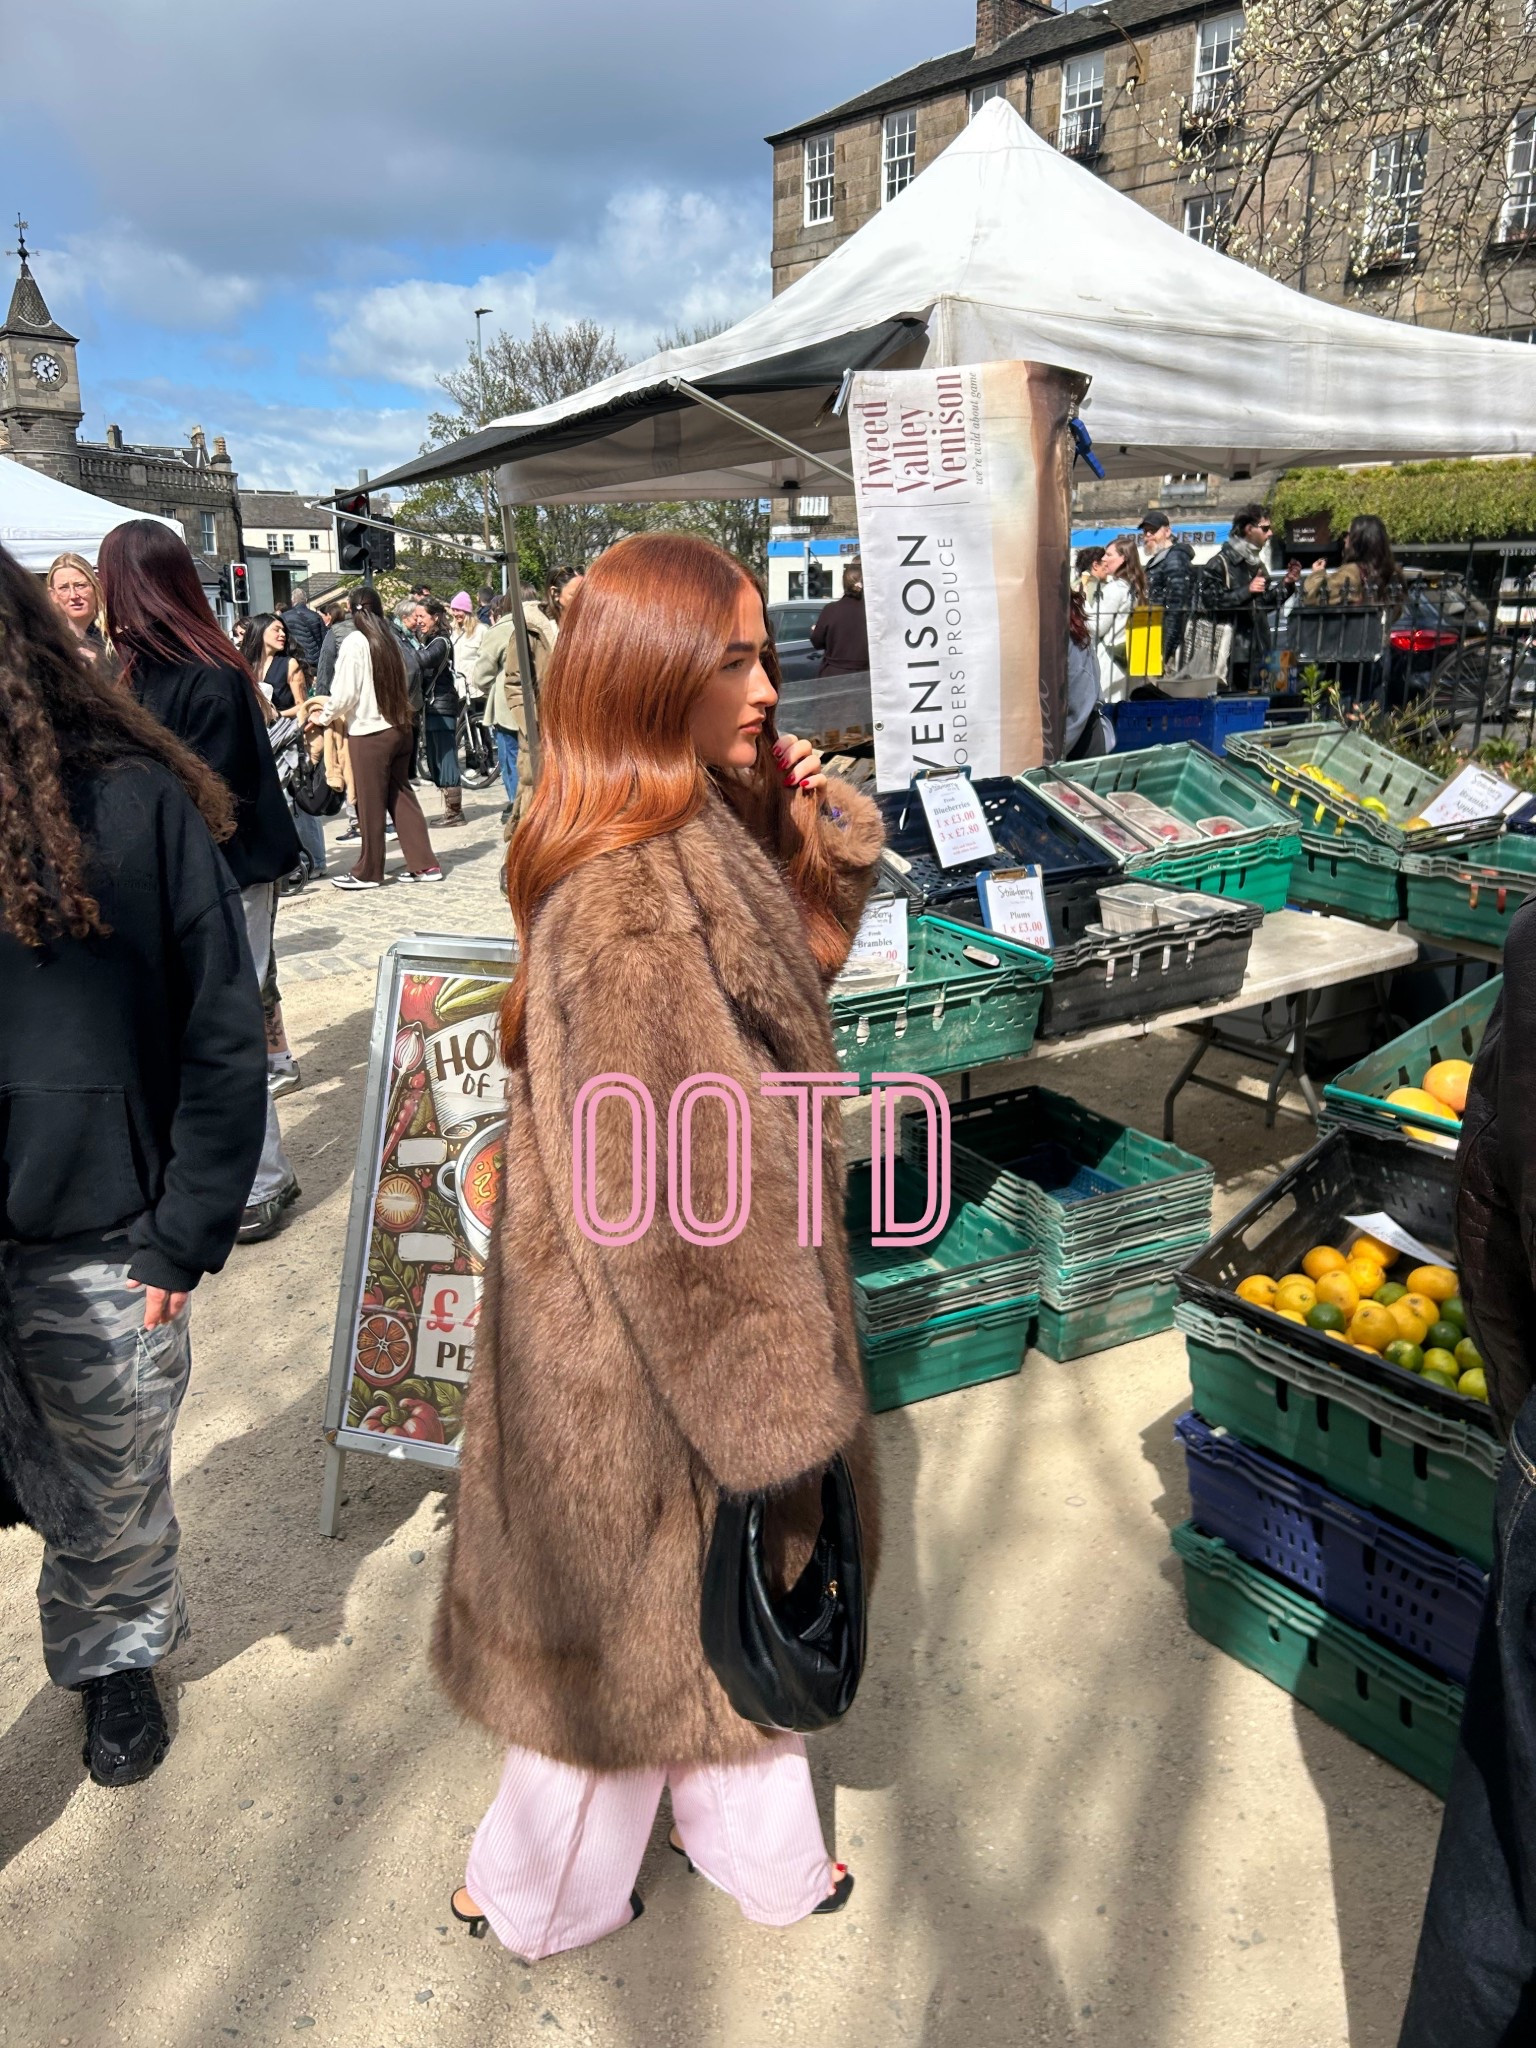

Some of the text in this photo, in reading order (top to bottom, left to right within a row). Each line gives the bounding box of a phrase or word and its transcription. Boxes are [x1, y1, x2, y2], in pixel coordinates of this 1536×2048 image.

[932, 373, 968, 493] Venison
[969, 372, 984, 485] we're wild about game
[853, 400, 894, 495] Tweed
[893, 404, 934, 494] Valley
[937, 538, 962, 655] PRODUCE
[933, 801, 971, 815] Blueberries
[936, 811, 976, 828] 1 x £3.00
[940, 824, 979, 842] 3 x £7.80
[1010, 911, 1031, 919] Plums
[1003, 924, 1007, 933] 1
[1019, 921, 1043, 932] £3.00
[858, 938, 892, 948] Brambles
